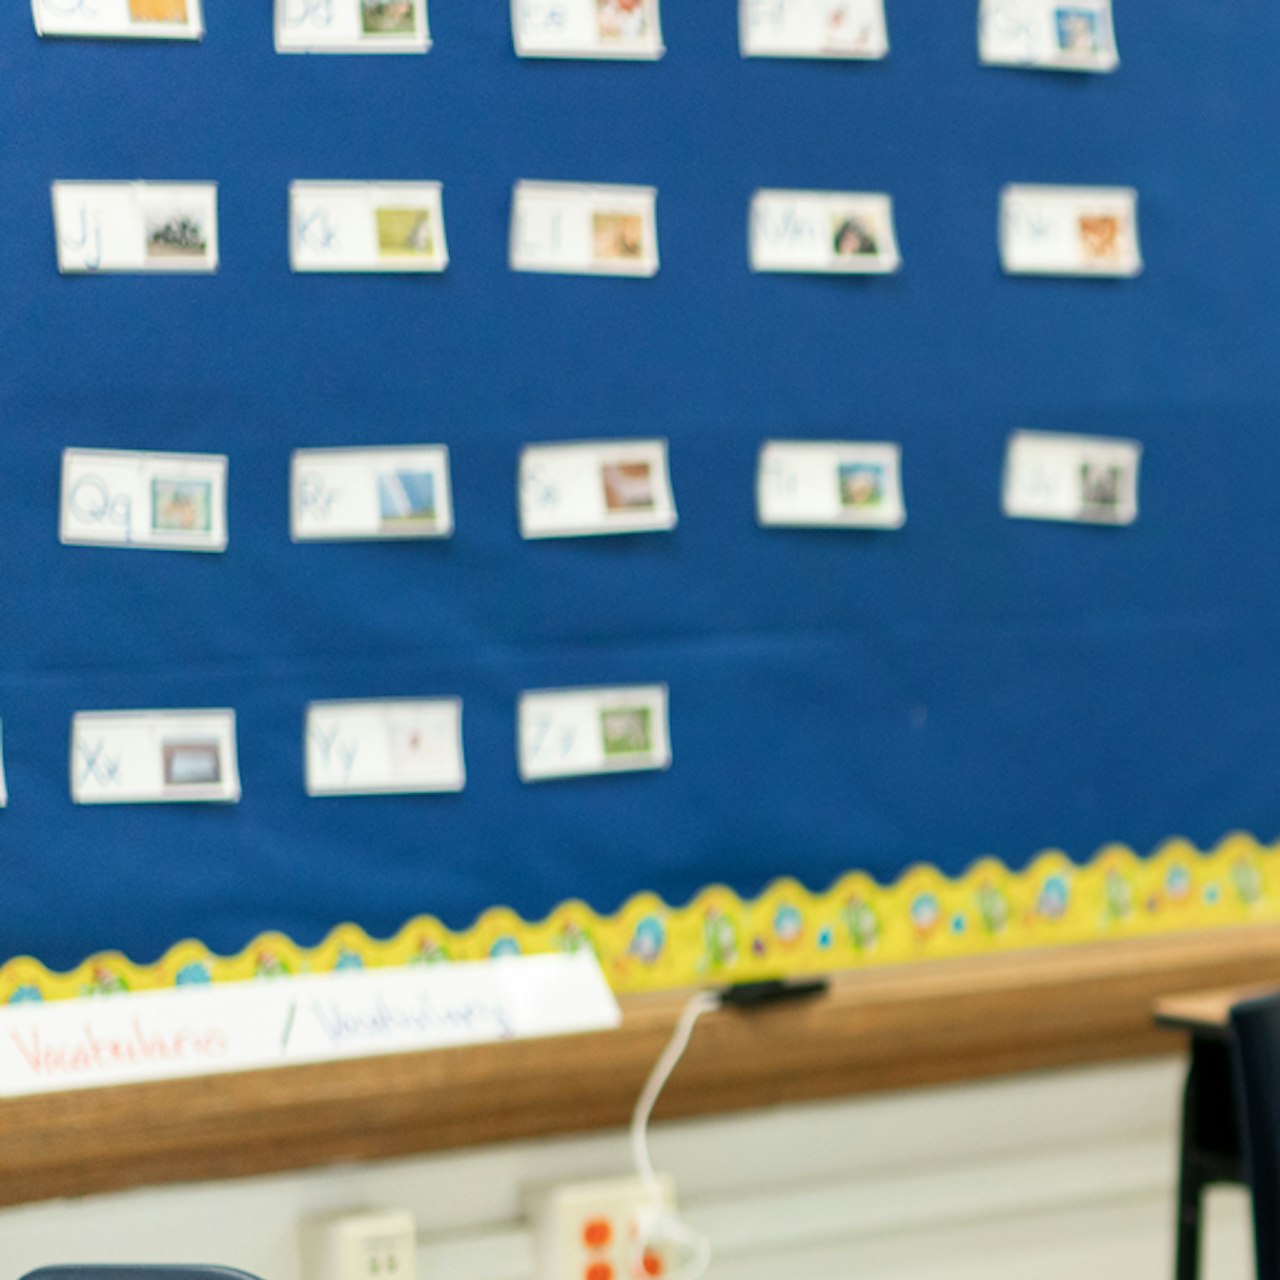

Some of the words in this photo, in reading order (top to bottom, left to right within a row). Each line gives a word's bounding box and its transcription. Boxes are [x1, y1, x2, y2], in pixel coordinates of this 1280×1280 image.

[68, 472, 132, 542] Qq
[77, 735, 122, 787] Xx
[312, 718, 360, 785] Yy
[9, 1014, 229, 1076] Vocabulario
[311, 990, 517, 1047] Vocabulary
